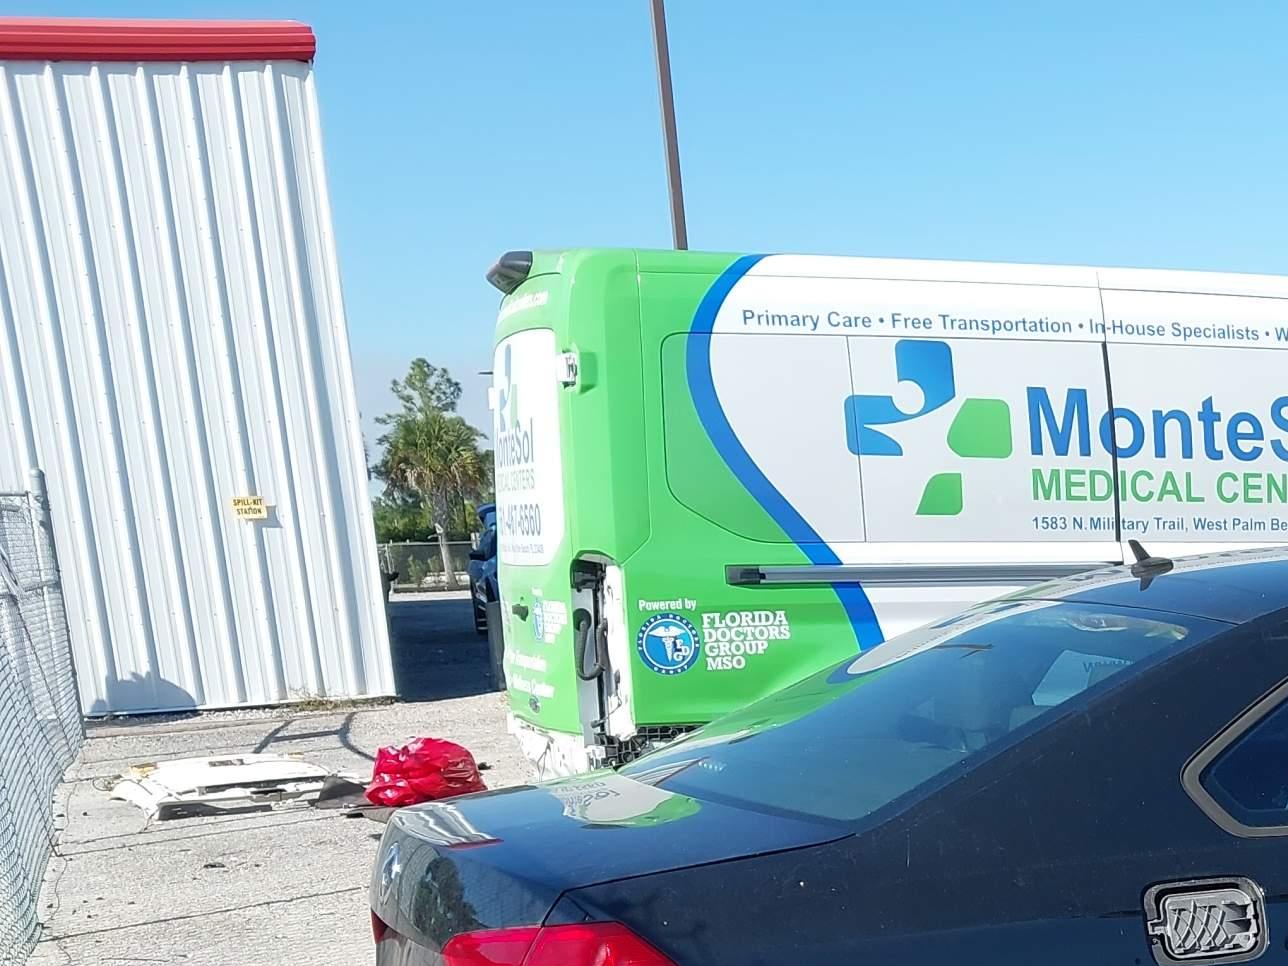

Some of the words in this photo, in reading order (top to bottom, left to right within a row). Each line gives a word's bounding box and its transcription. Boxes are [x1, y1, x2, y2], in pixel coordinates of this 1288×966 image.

[742, 309, 820, 331] Primary
[827, 311, 872, 328] Care
[891, 313, 933, 330] Free
[939, 314, 1072, 334] Transportation
[1089, 318, 1166, 337] In-House
[1171, 321, 1259, 342] Specialists
[1031, 468, 1205, 503] MEDICAL
[1032, 516, 1068, 530] 1583
[1154, 517, 1188, 532] Trail,
[1193, 517, 1228, 531] West
[1232, 517, 1266, 531] Palm
[638, 598, 683, 612] Powered
[684, 597, 697, 612] by
[701, 610, 789, 628] FLORIDA
[703, 625, 791, 643] DOCTORS
[704, 640, 769, 657] GROUP
[706, 656, 746, 671] MSO
